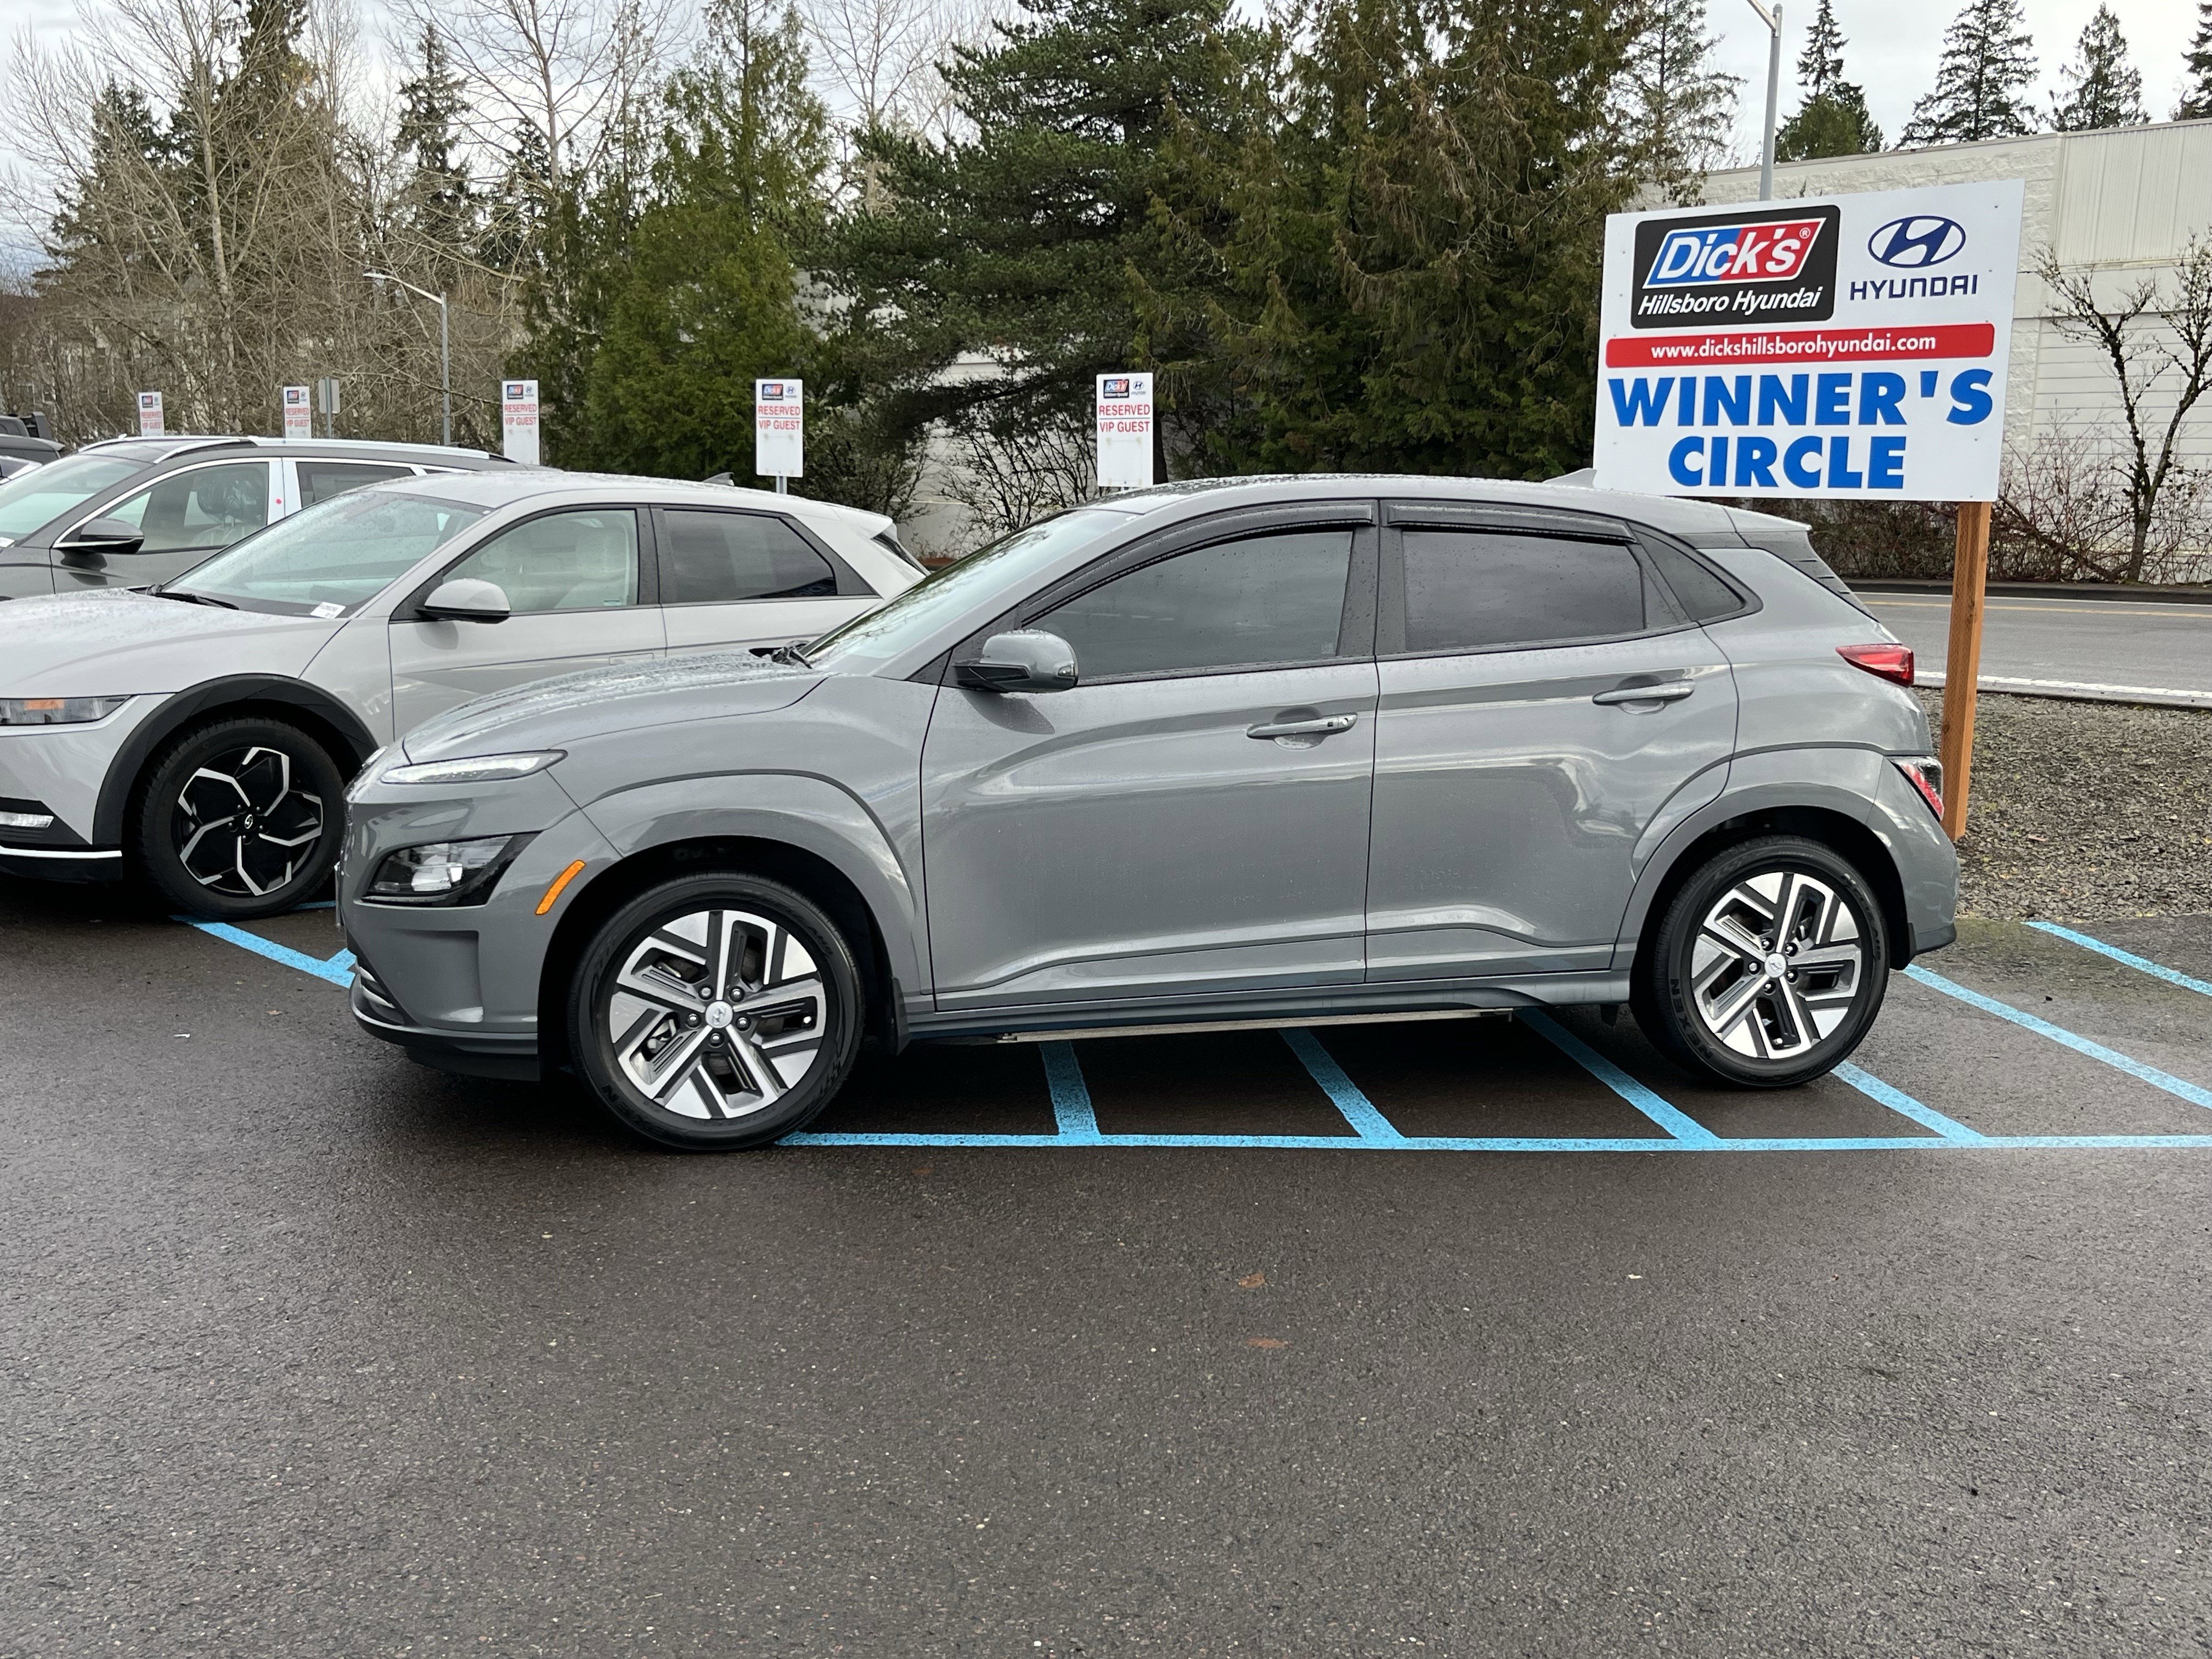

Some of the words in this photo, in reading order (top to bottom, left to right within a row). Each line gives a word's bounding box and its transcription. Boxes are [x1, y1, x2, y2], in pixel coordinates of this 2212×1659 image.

[1850, 274, 1978, 301] HYUNDAI
[1638, 292, 1729, 315] Hillsboro
[1732, 286, 1824, 315] Hyundai
[1650, 332, 1937, 359] www.dickshillsborohyundai.com
[1608, 368, 1993, 427] WINNER'S
[504, 404, 537, 413] RESERVED
[758, 405, 800, 416] RESERVED
[1099, 404, 1150, 416] RESERVED
[505, 417, 515, 425] VIP
[516, 416, 537, 425] GUEST
[759, 420, 771, 430] VIP
[774, 420, 800, 430] GUEST
[1099, 421, 1114, 432] VIP
[1117, 421, 1150, 432] GUEST
[1668, 435, 1906, 489] CIRCLE
[1670, 978, 1714, 1060] NEXEN
